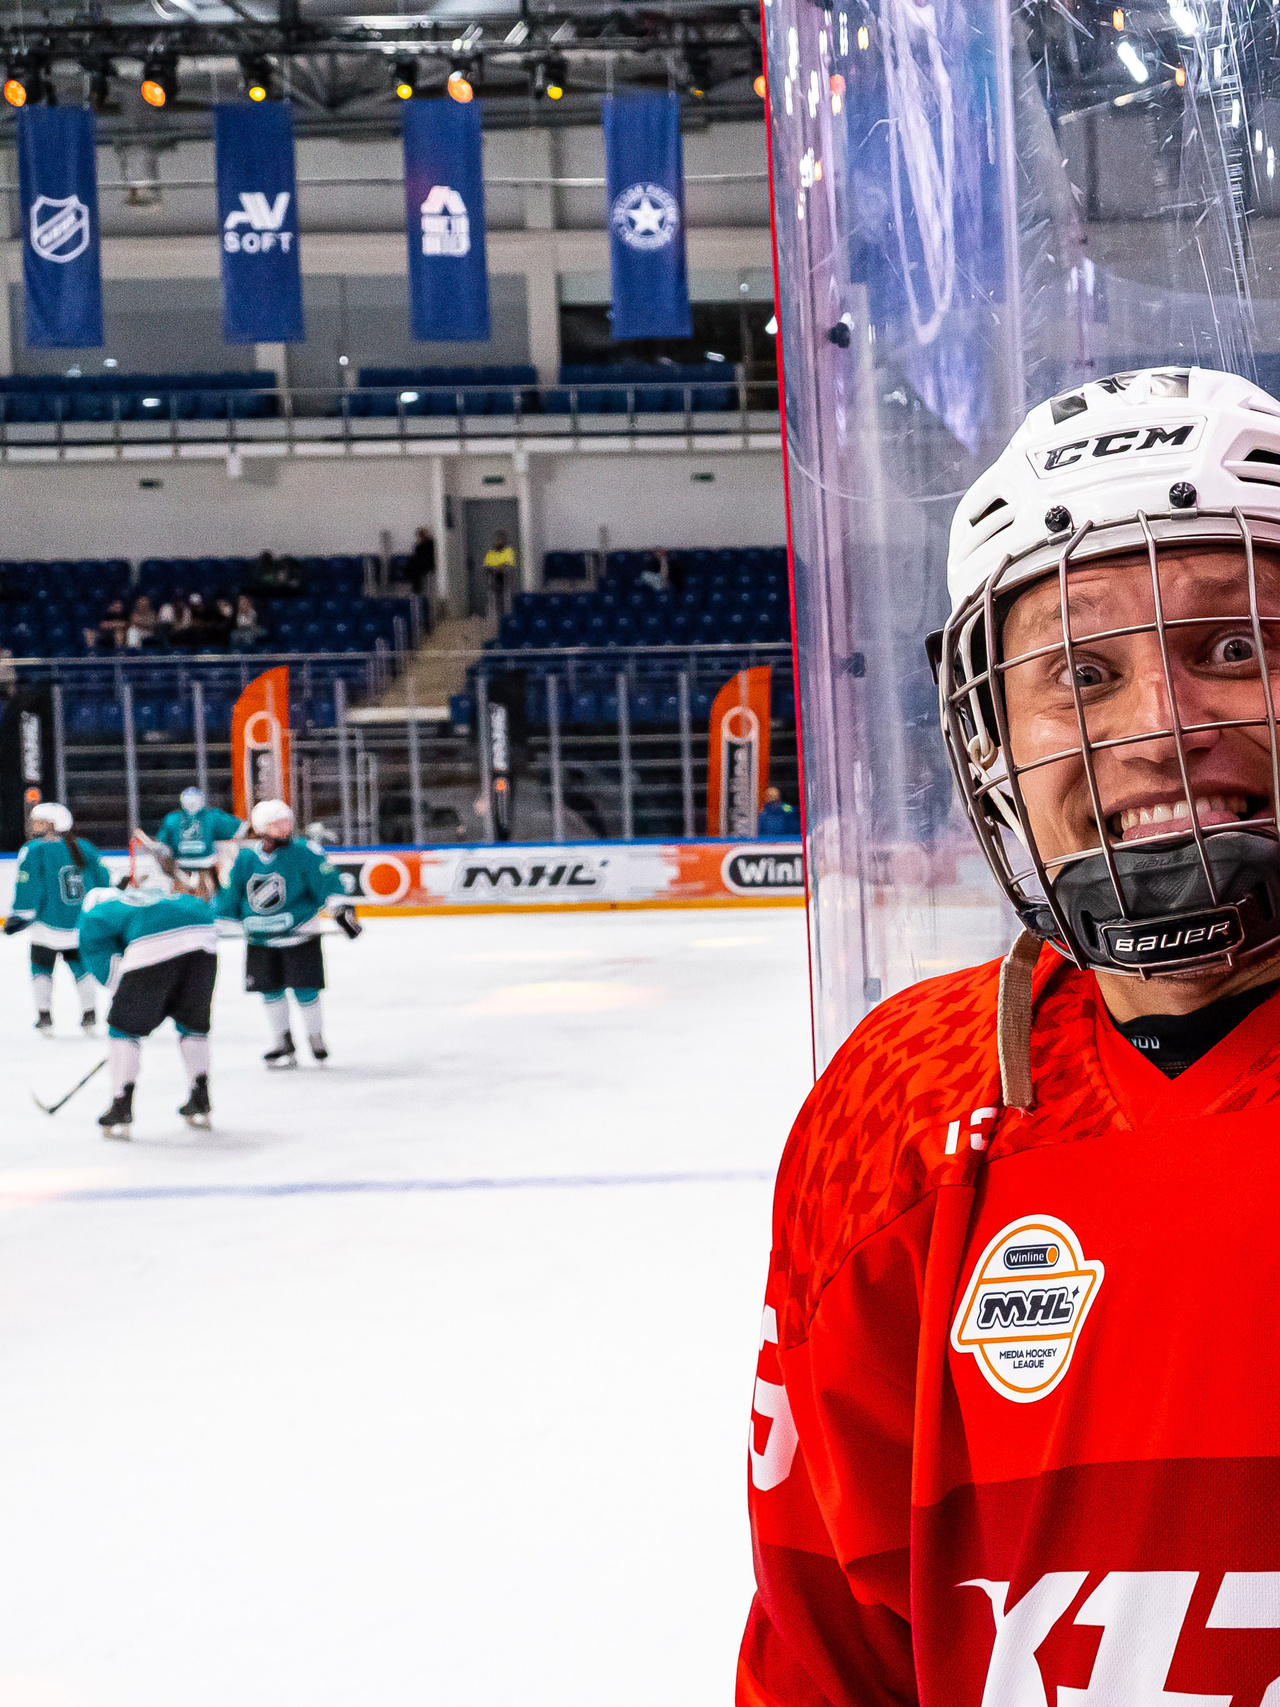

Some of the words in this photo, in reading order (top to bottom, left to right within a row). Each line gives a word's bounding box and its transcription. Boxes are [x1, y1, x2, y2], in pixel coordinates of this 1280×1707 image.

[224, 231, 293, 254] SOFT
[1044, 425, 1195, 471] CCM
[1132, 852, 1198, 871] BAUR
[463, 864, 597, 888] MHL
[1114, 920, 1231, 952] BAUER
[1009, 1251, 1045, 1265] Winline
[980, 1290, 1073, 1325] MHL
[999, 1350, 1024, 1359] MEDIA
[1026, 1348, 1057, 1358] HOCKEY
[1013, 1359, 1044, 1368] LEAGUE
